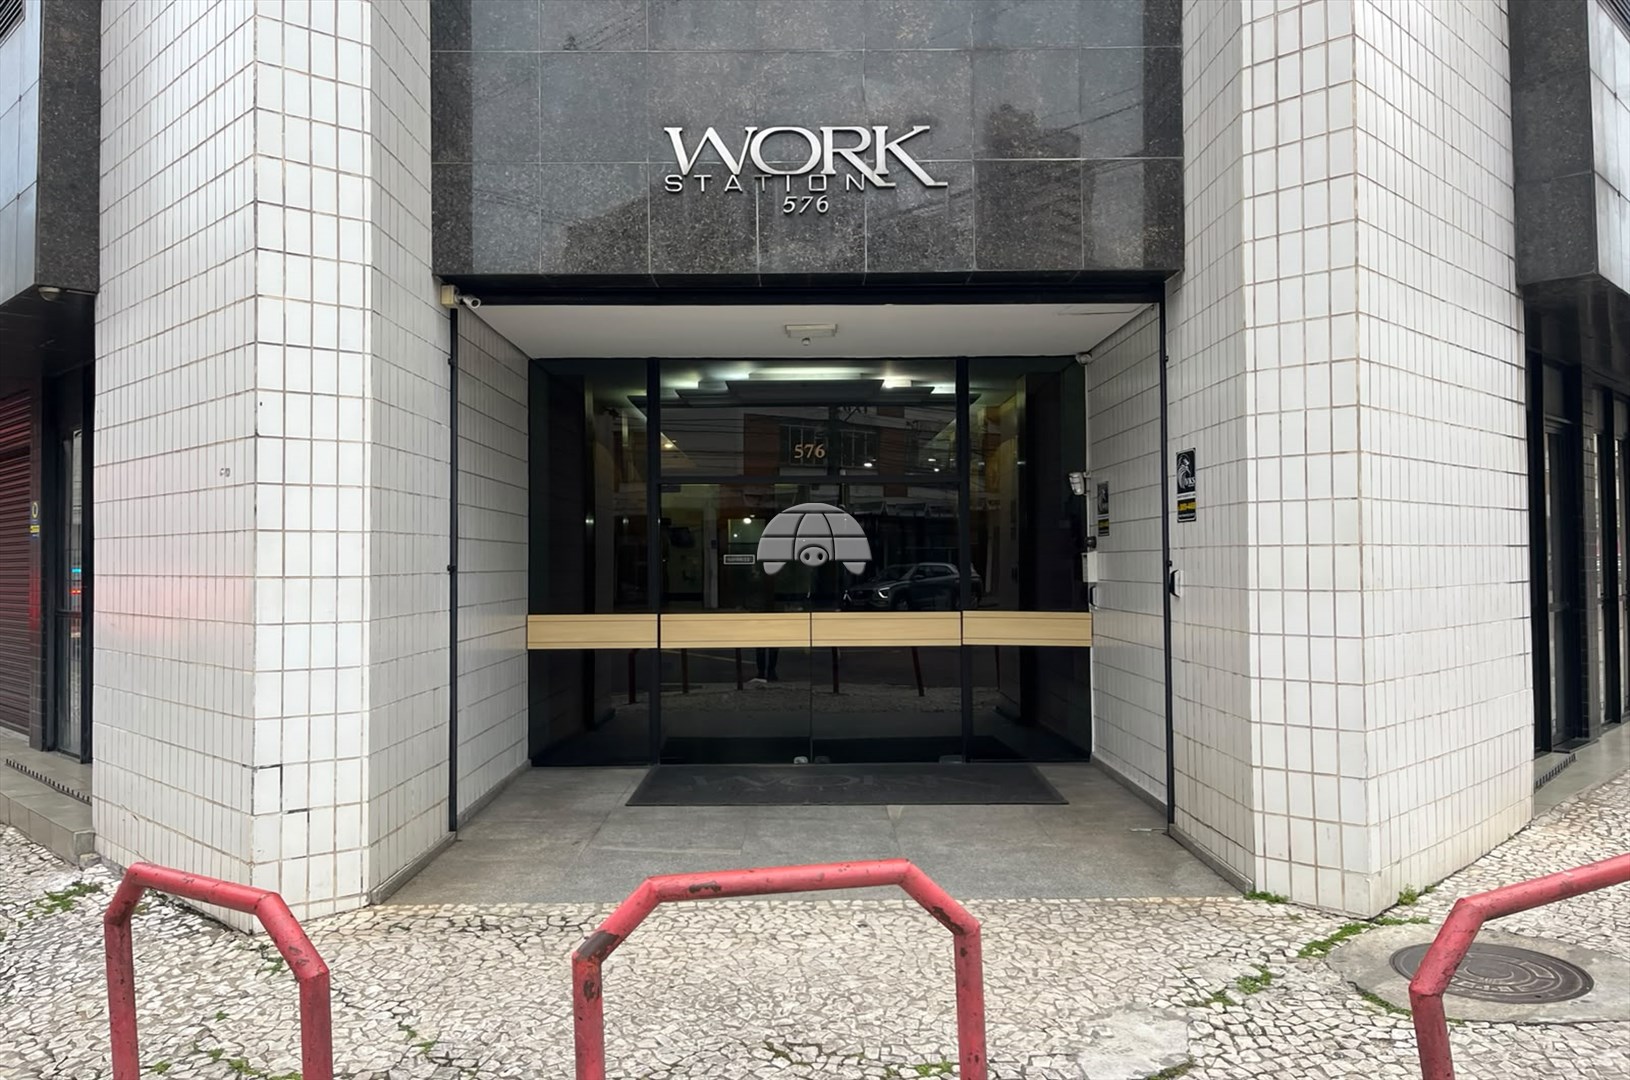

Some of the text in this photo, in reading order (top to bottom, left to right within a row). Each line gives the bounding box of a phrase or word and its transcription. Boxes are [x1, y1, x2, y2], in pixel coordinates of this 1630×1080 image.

[664, 125, 948, 187] WORK
[664, 174, 866, 192] STATION
[782, 196, 829, 213] 576
[794, 443, 826, 459] 576
